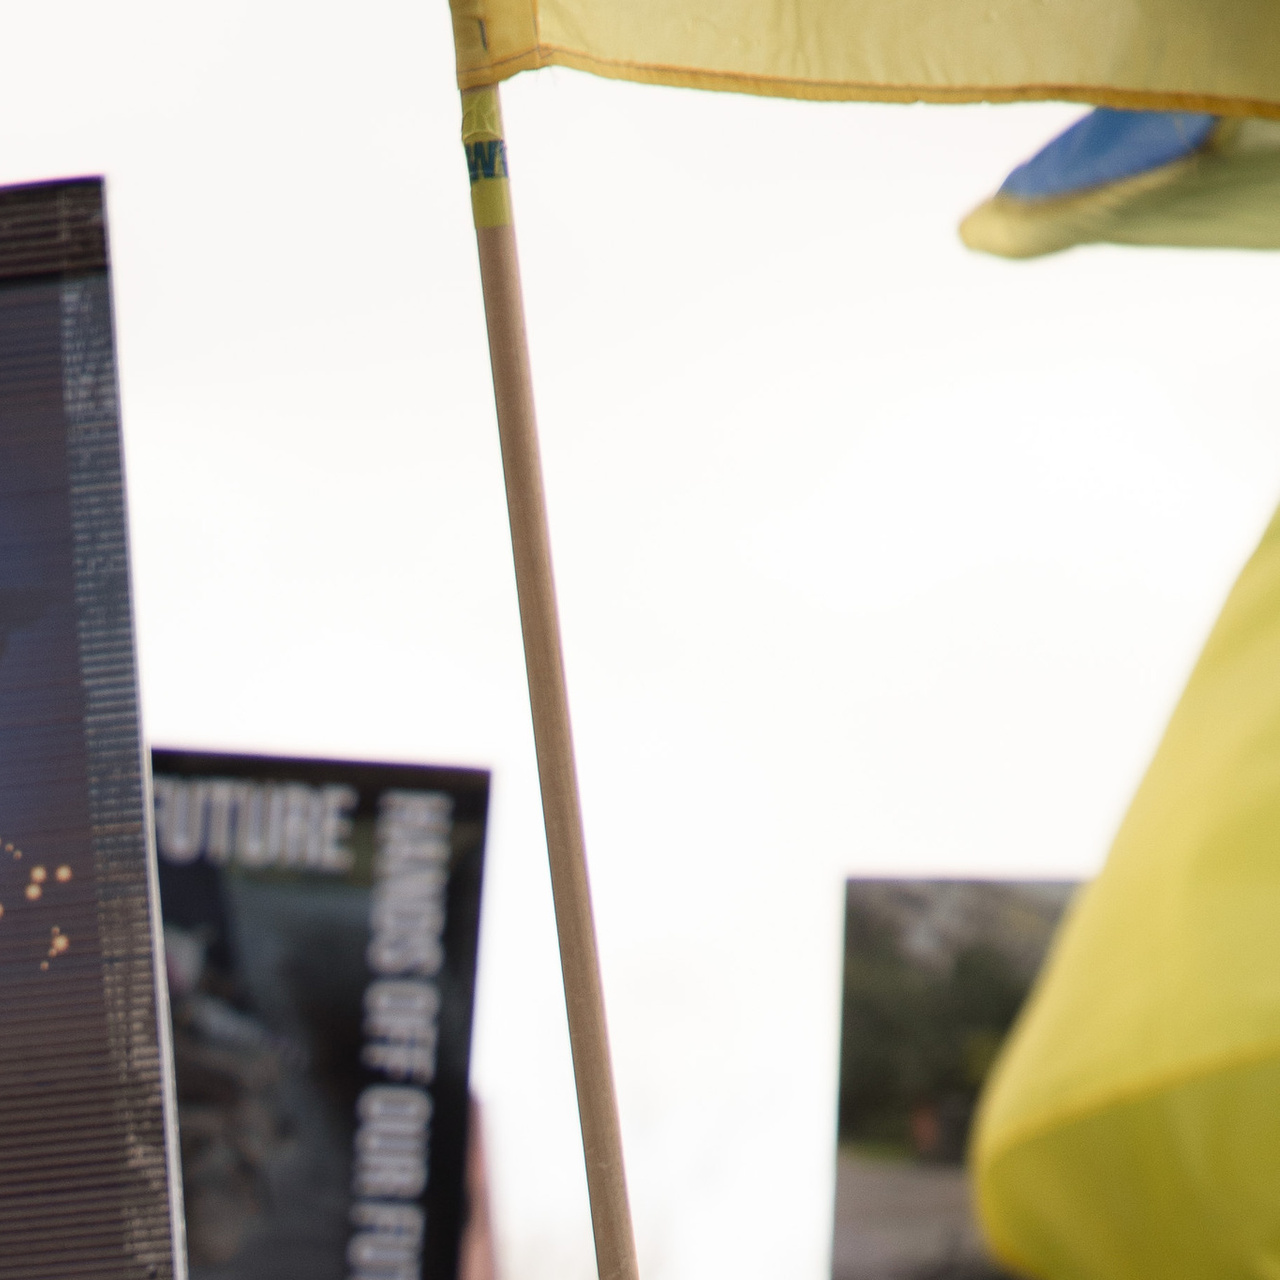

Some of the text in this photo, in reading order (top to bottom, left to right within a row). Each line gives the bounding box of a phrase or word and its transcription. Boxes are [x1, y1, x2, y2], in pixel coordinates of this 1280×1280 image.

[367, 790, 454, 978] HANDS
[361, 980, 440, 1083] OFF
[353, 1084, 434, 1201] OUR
